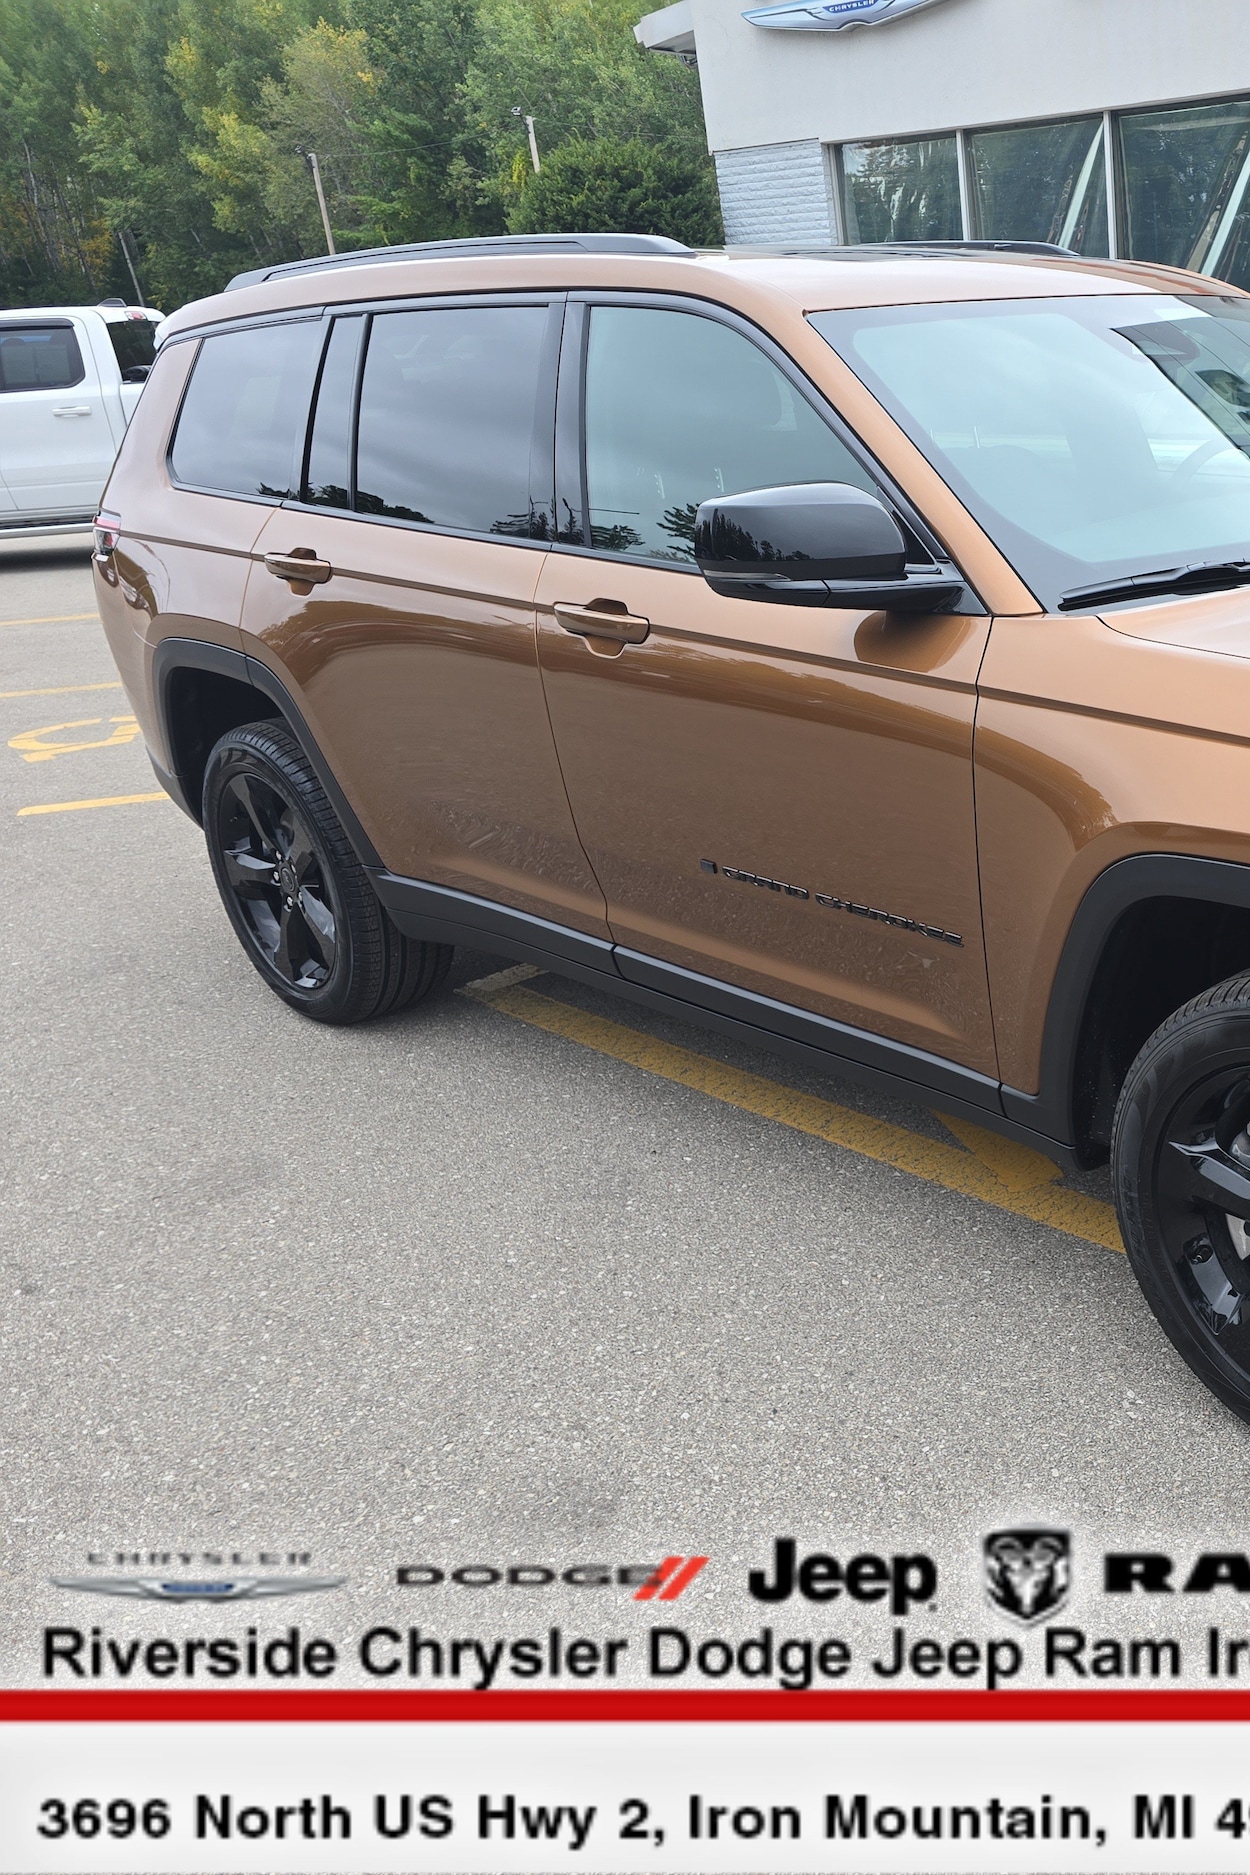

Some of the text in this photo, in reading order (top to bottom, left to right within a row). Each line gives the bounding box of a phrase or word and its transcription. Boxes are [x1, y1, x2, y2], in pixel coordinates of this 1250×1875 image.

[828, 0, 875, 12] CHRYSLER
[721, 864, 965, 948] GRAND CHEROKEE
